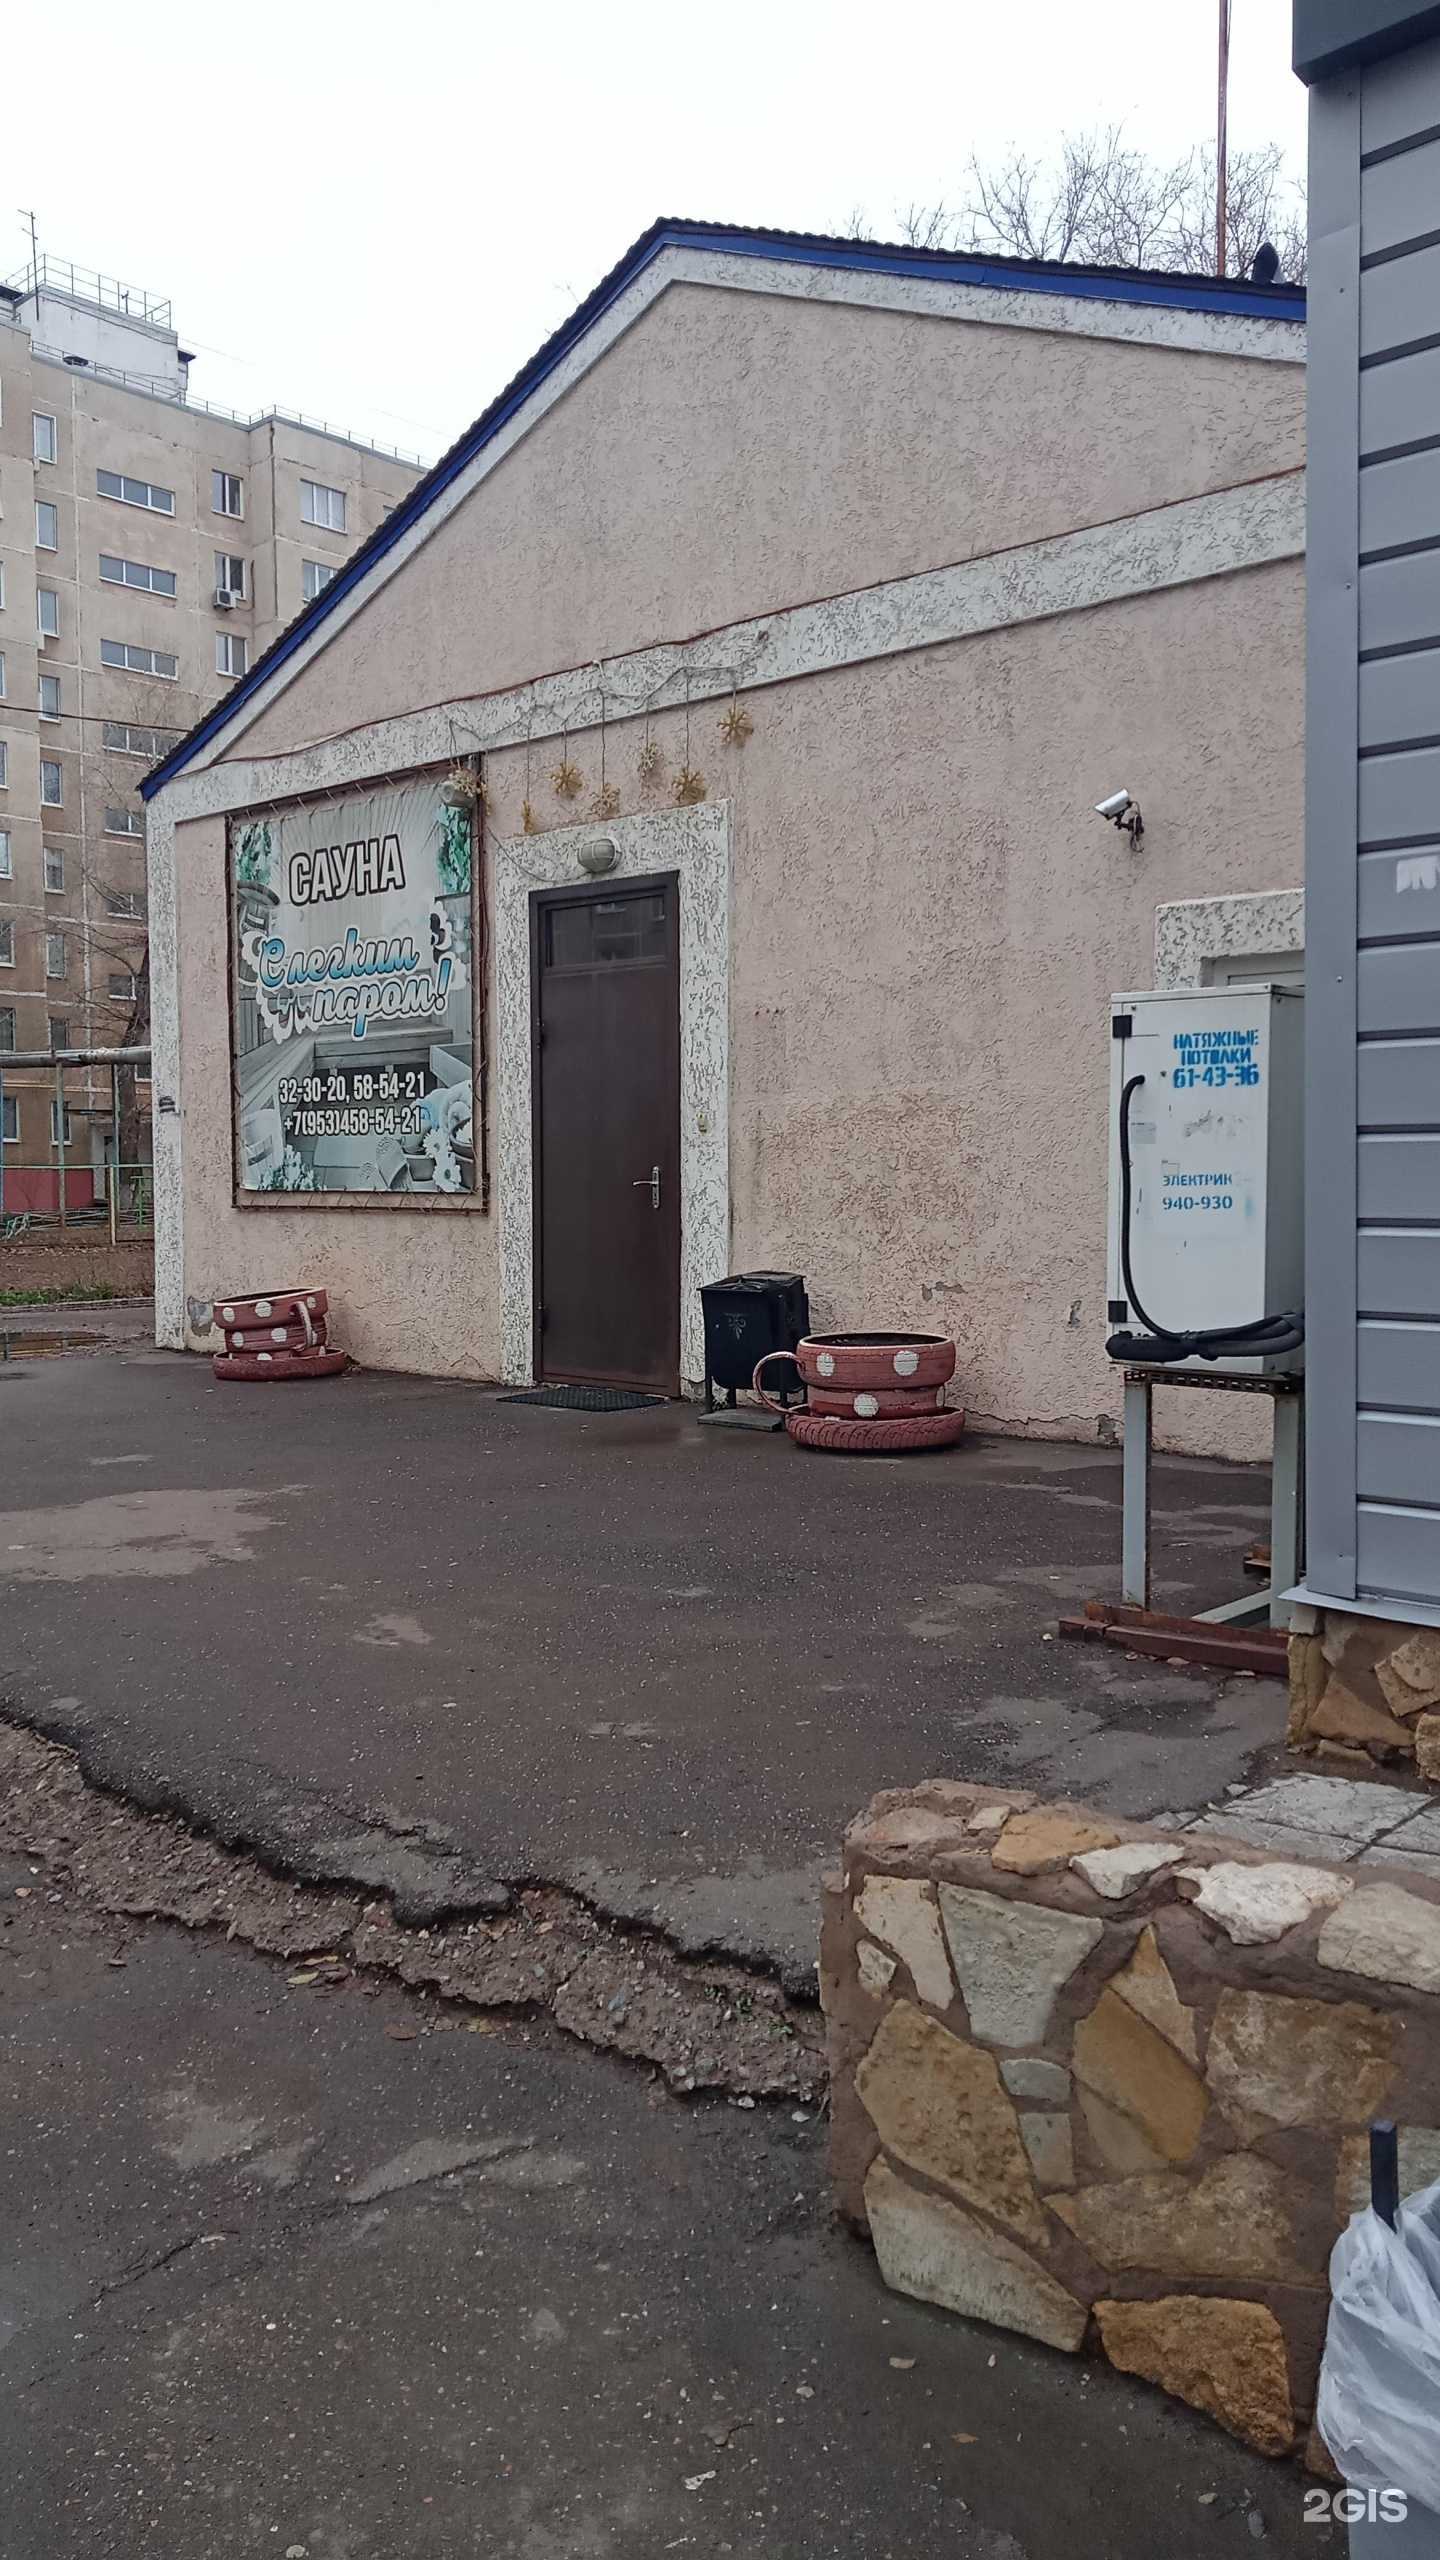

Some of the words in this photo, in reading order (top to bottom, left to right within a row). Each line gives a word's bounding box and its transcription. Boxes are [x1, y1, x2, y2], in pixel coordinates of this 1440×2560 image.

[288, 833, 406, 907] САУНА
[312, 957, 453, 1038] паром!
[1173, 1029, 1259, 1050] НАТЯЖНЫЕ
[1181, 1047, 1252, 1066] ПОТОЛКИ
[278, 1075, 350, 1104] 32-30-20,
[352, 1071, 425, 1100] 58-54-21
[1173, 1063, 1260, 1088] 61-43-36
[283, 1105, 422, 1136] +7(953)458-54-21
[1162, 1172, 1233, 1187] ЭЛЕКТРИК
[1162, 1195, 1233, 1211] 940-930
